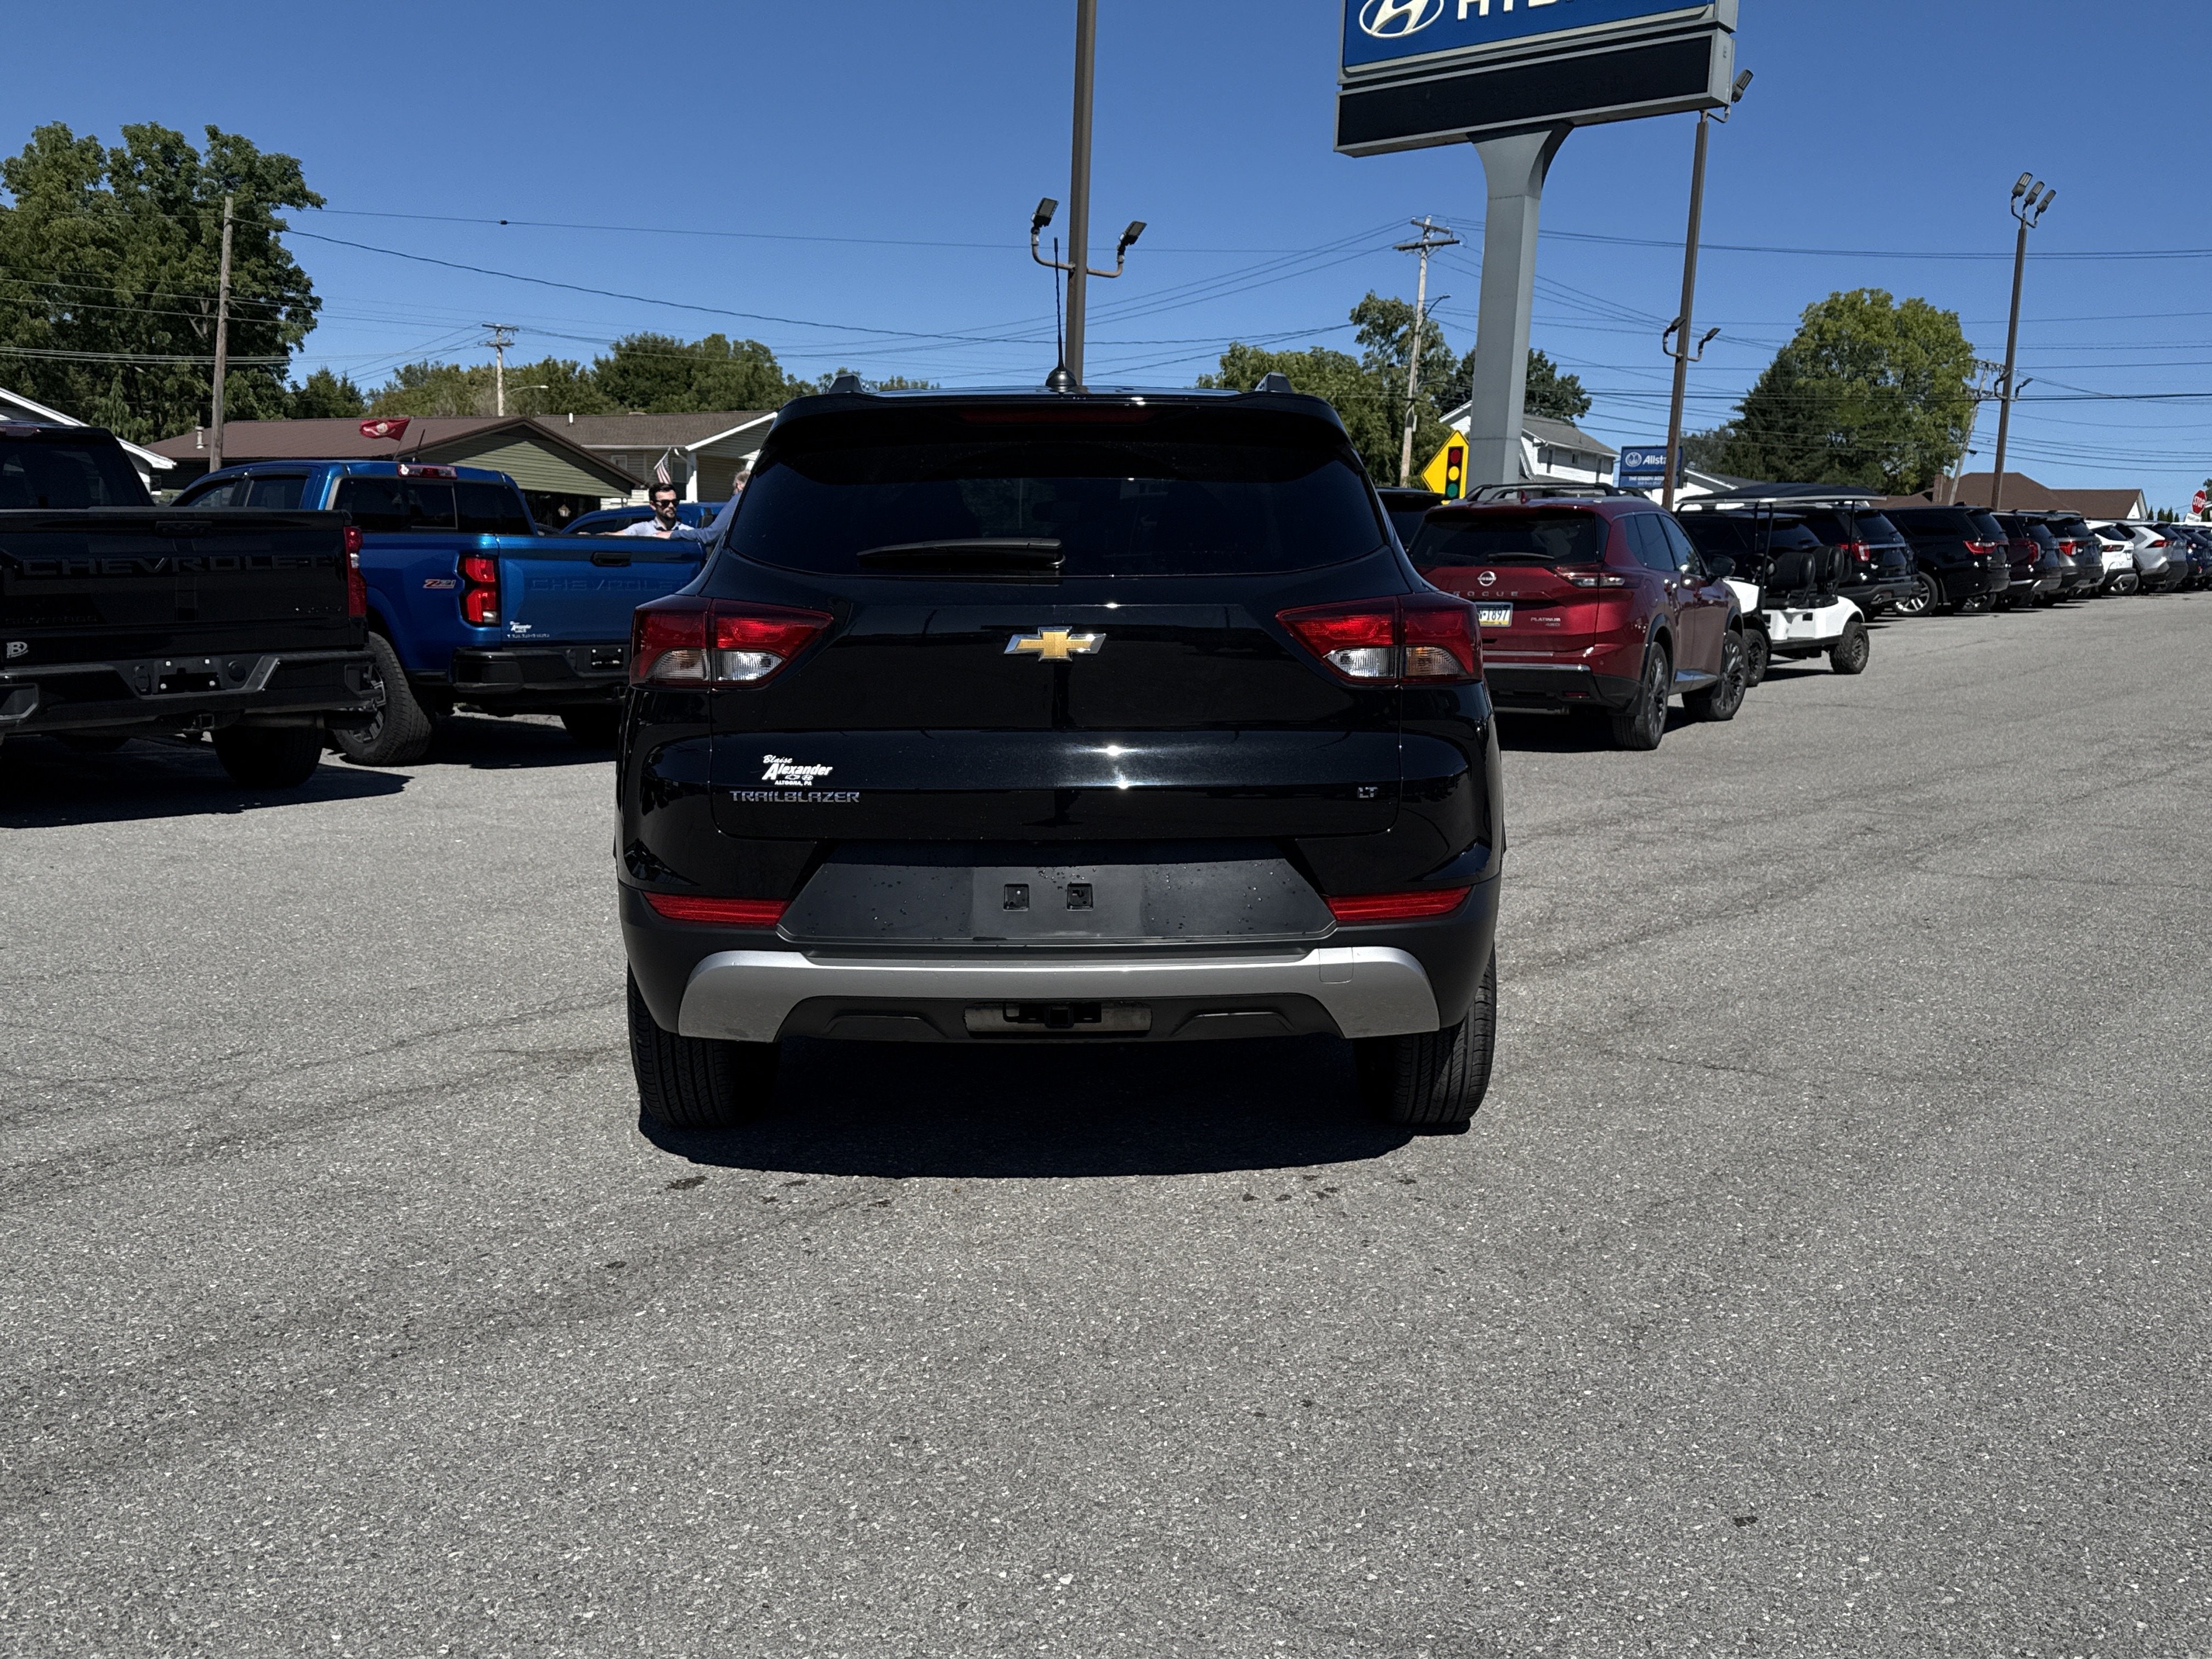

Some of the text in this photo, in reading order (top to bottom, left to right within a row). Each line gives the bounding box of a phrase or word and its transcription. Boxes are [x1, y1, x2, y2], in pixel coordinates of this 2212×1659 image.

[1643, 455, 1667, 465] Allsta
[2193, 496, 2205, 508] STOP
[22, 555, 335, 576] CHEVROLET
[763, 754, 793, 763] Blaise
[761, 763, 833, 780] Alexander
[729, 791, 860, 803] TRAILBLAZER
[1357, 787, 1378, 798] LT
